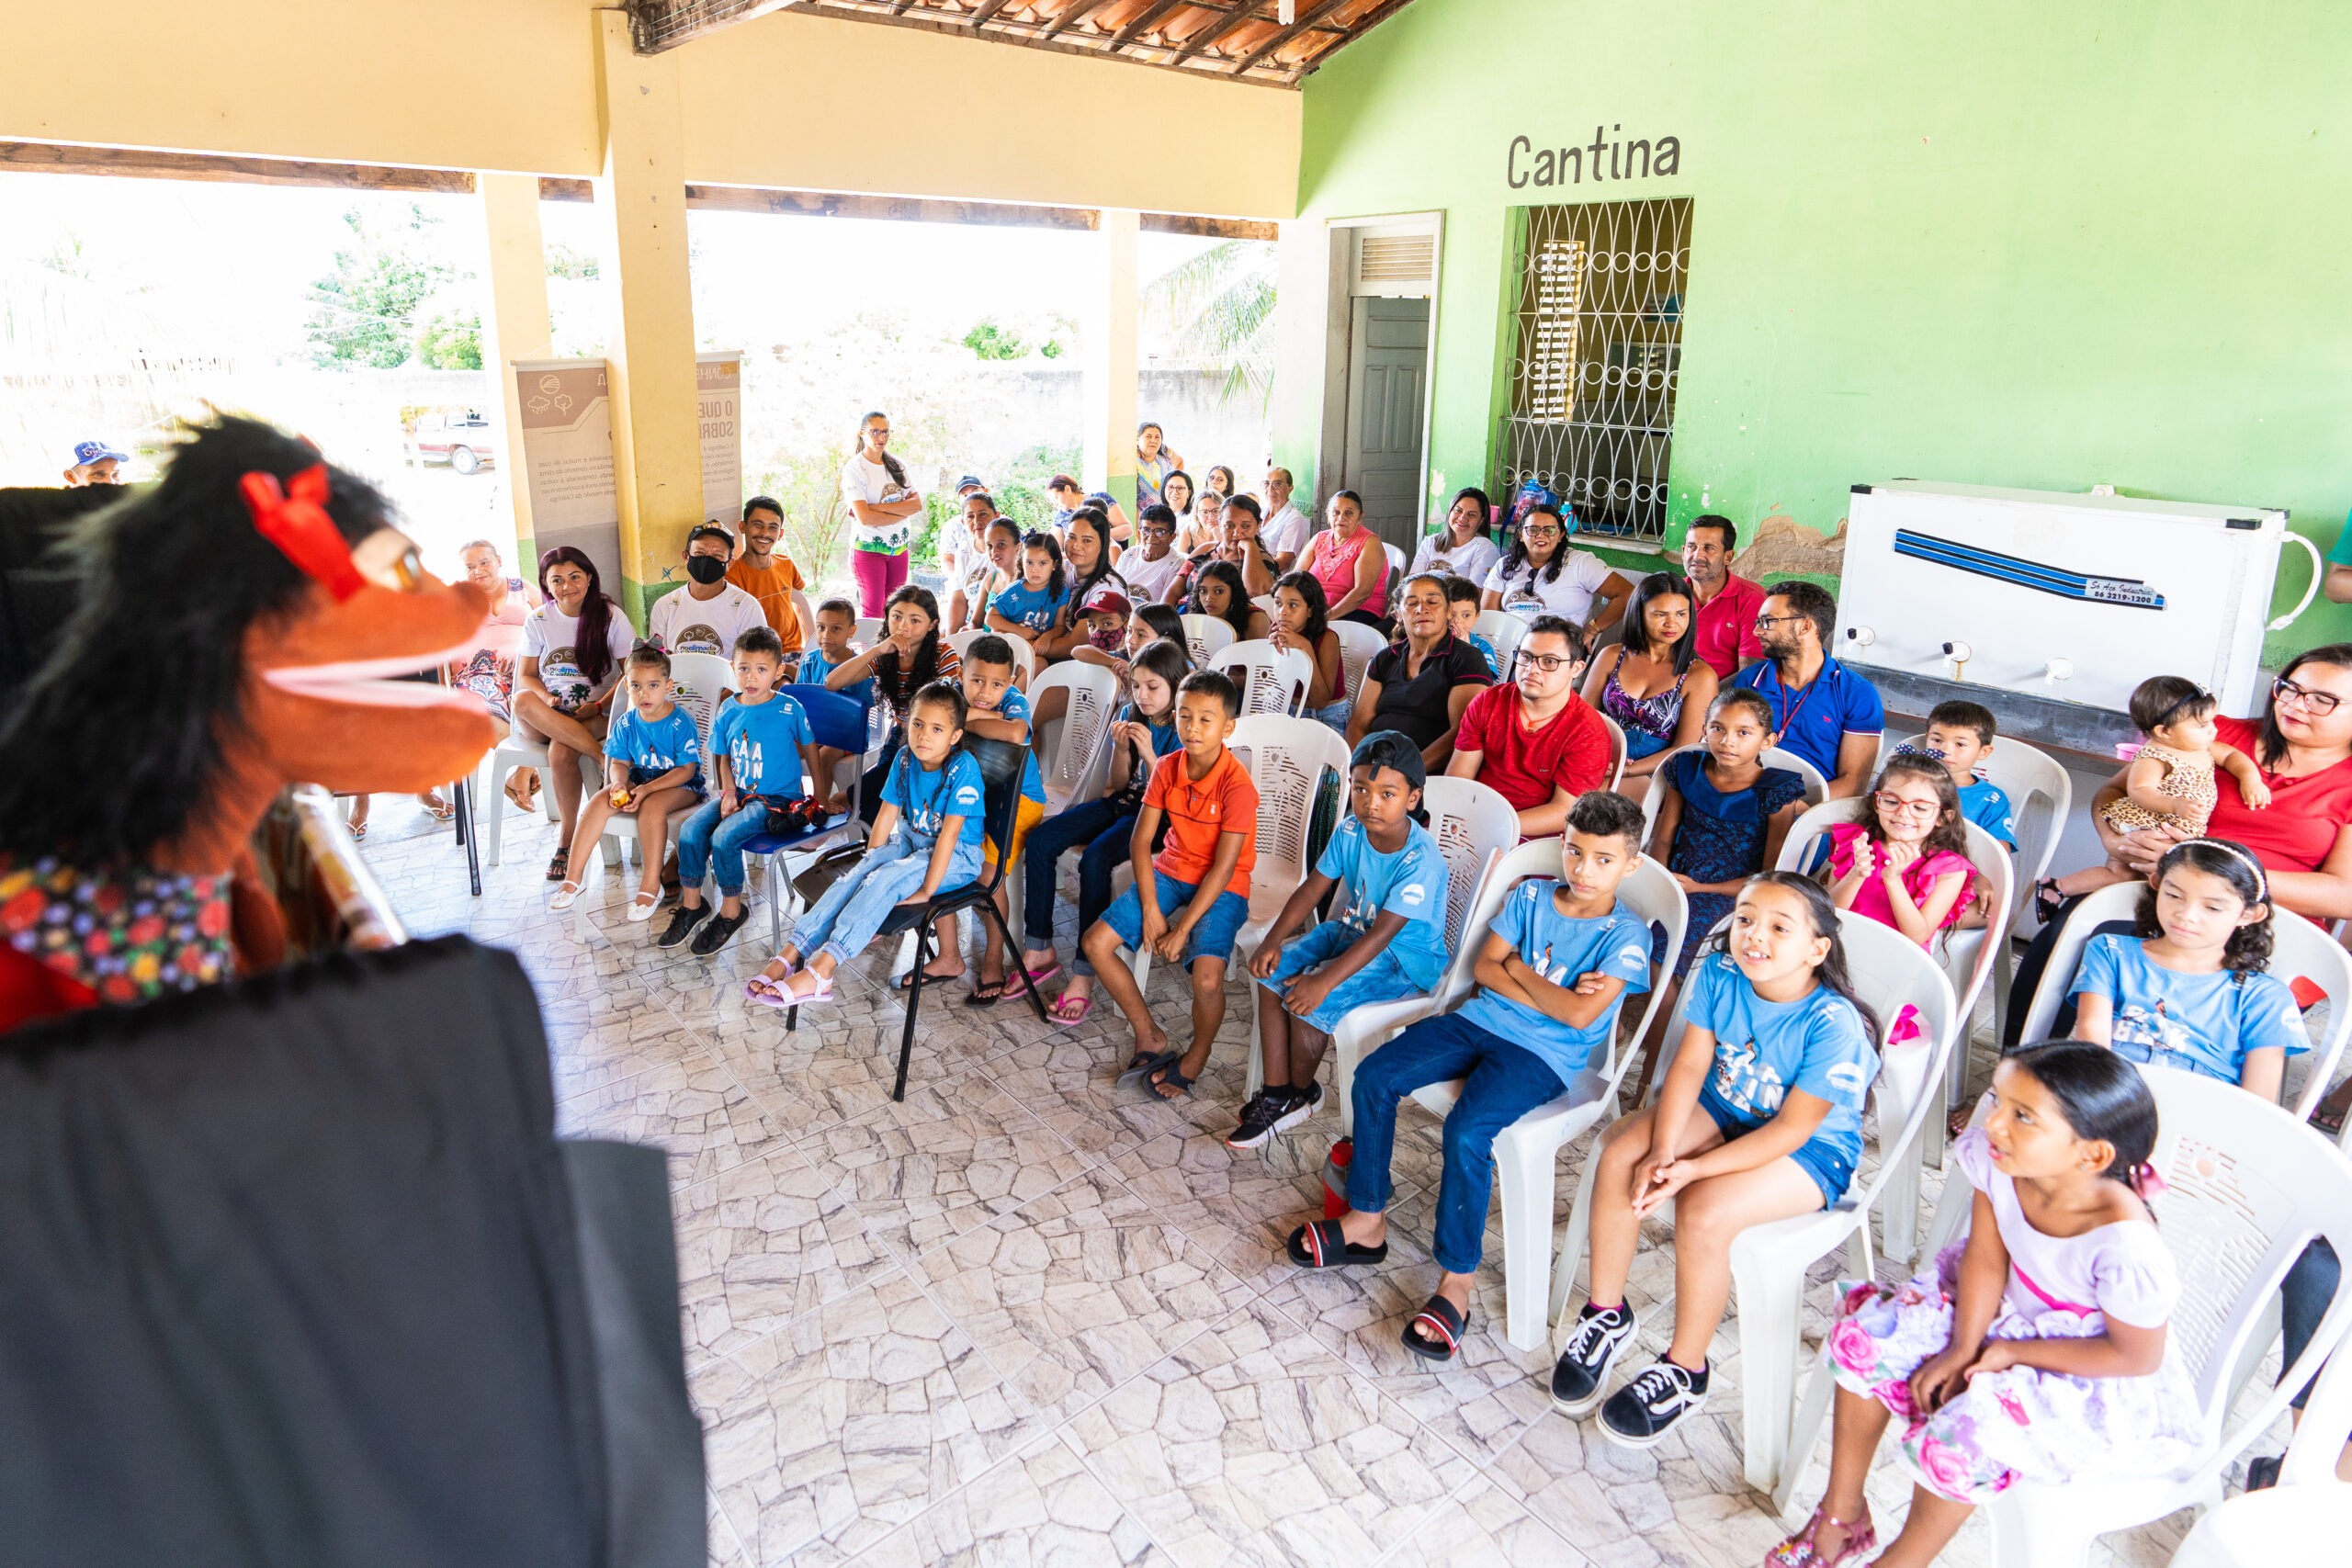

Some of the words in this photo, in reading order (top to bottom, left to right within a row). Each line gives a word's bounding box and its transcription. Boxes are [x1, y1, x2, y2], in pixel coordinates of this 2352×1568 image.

[1508, 123, 1680, 189] Cantina
[2107, 592, 2152, 604] 3219-1200
[731, 739, 763, 761] CAA
